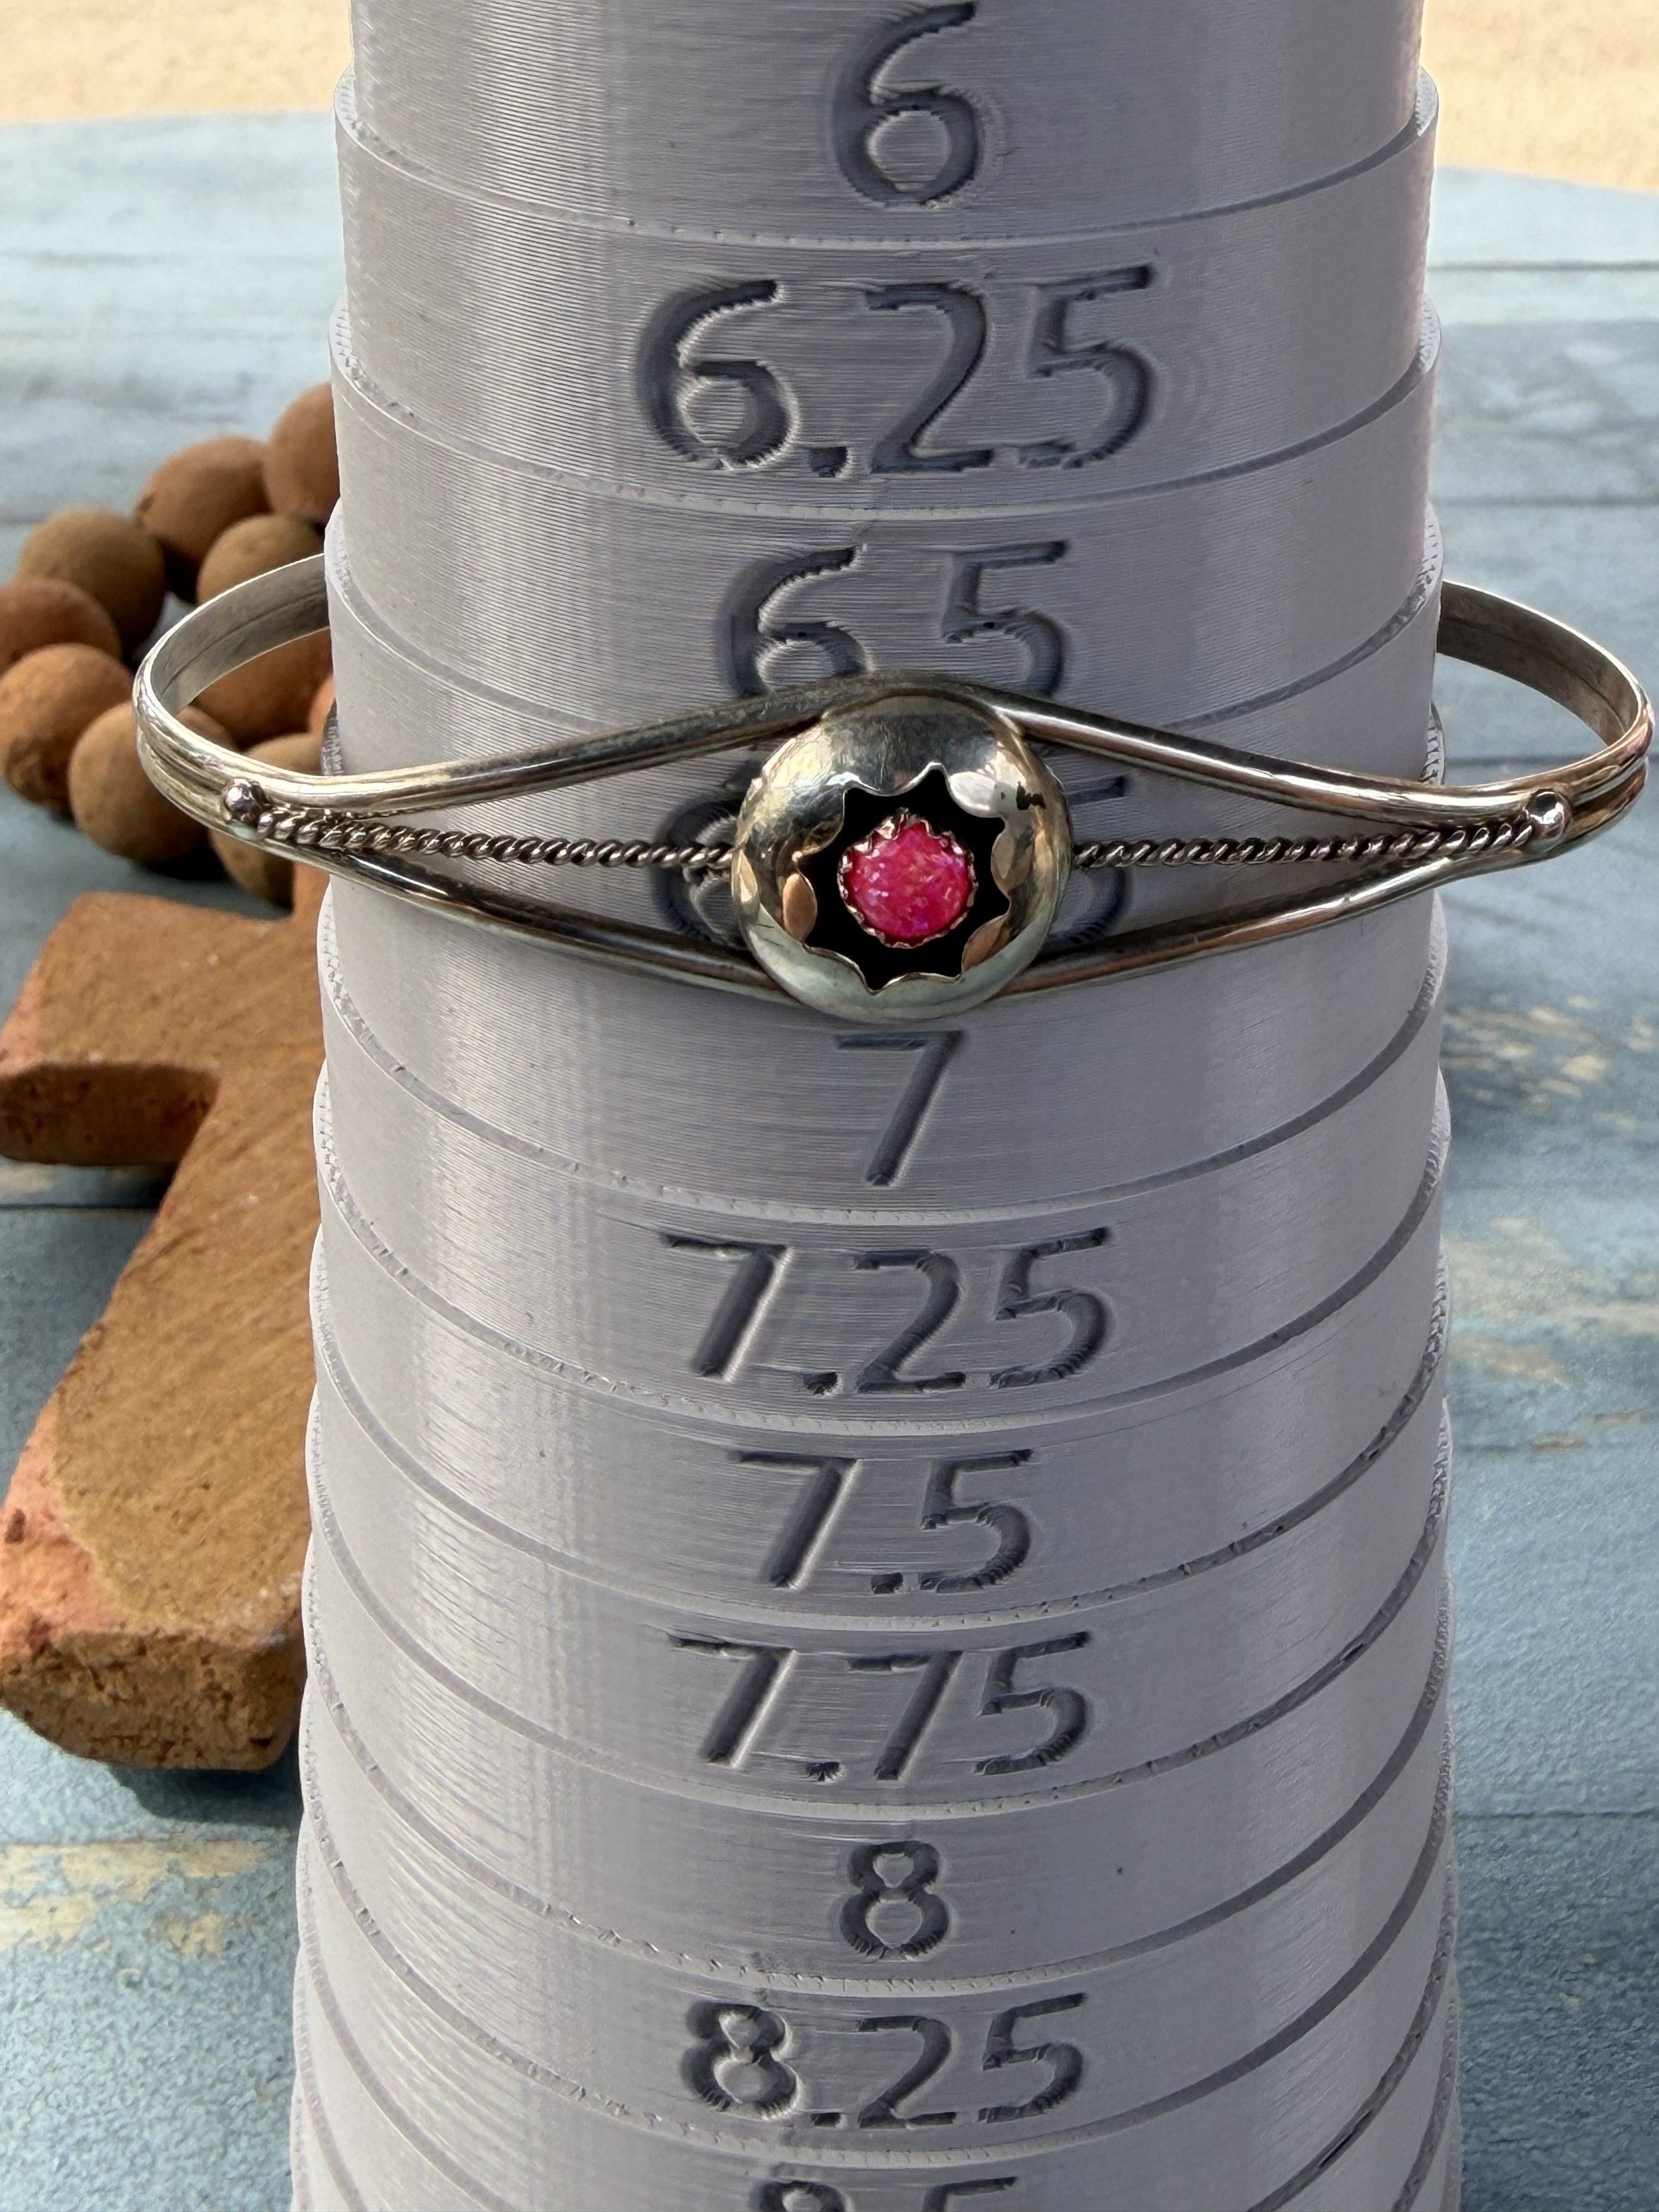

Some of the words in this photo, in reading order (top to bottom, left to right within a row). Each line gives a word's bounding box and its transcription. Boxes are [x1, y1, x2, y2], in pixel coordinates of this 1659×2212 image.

[832, 1, 982, 206] 6
[637, 263, 1155, 477] 6.25
[836, 1029, 964, 1186] 7
[662, 1226, 1111, 1394] 7.25
[730, 1448, 1035, 1594] 7.5
[667, 1630, 1092, 1782] 7.75
[839, 1839, 951, 1960] 8
[681, 1992, 1088, 2128] 8.25
